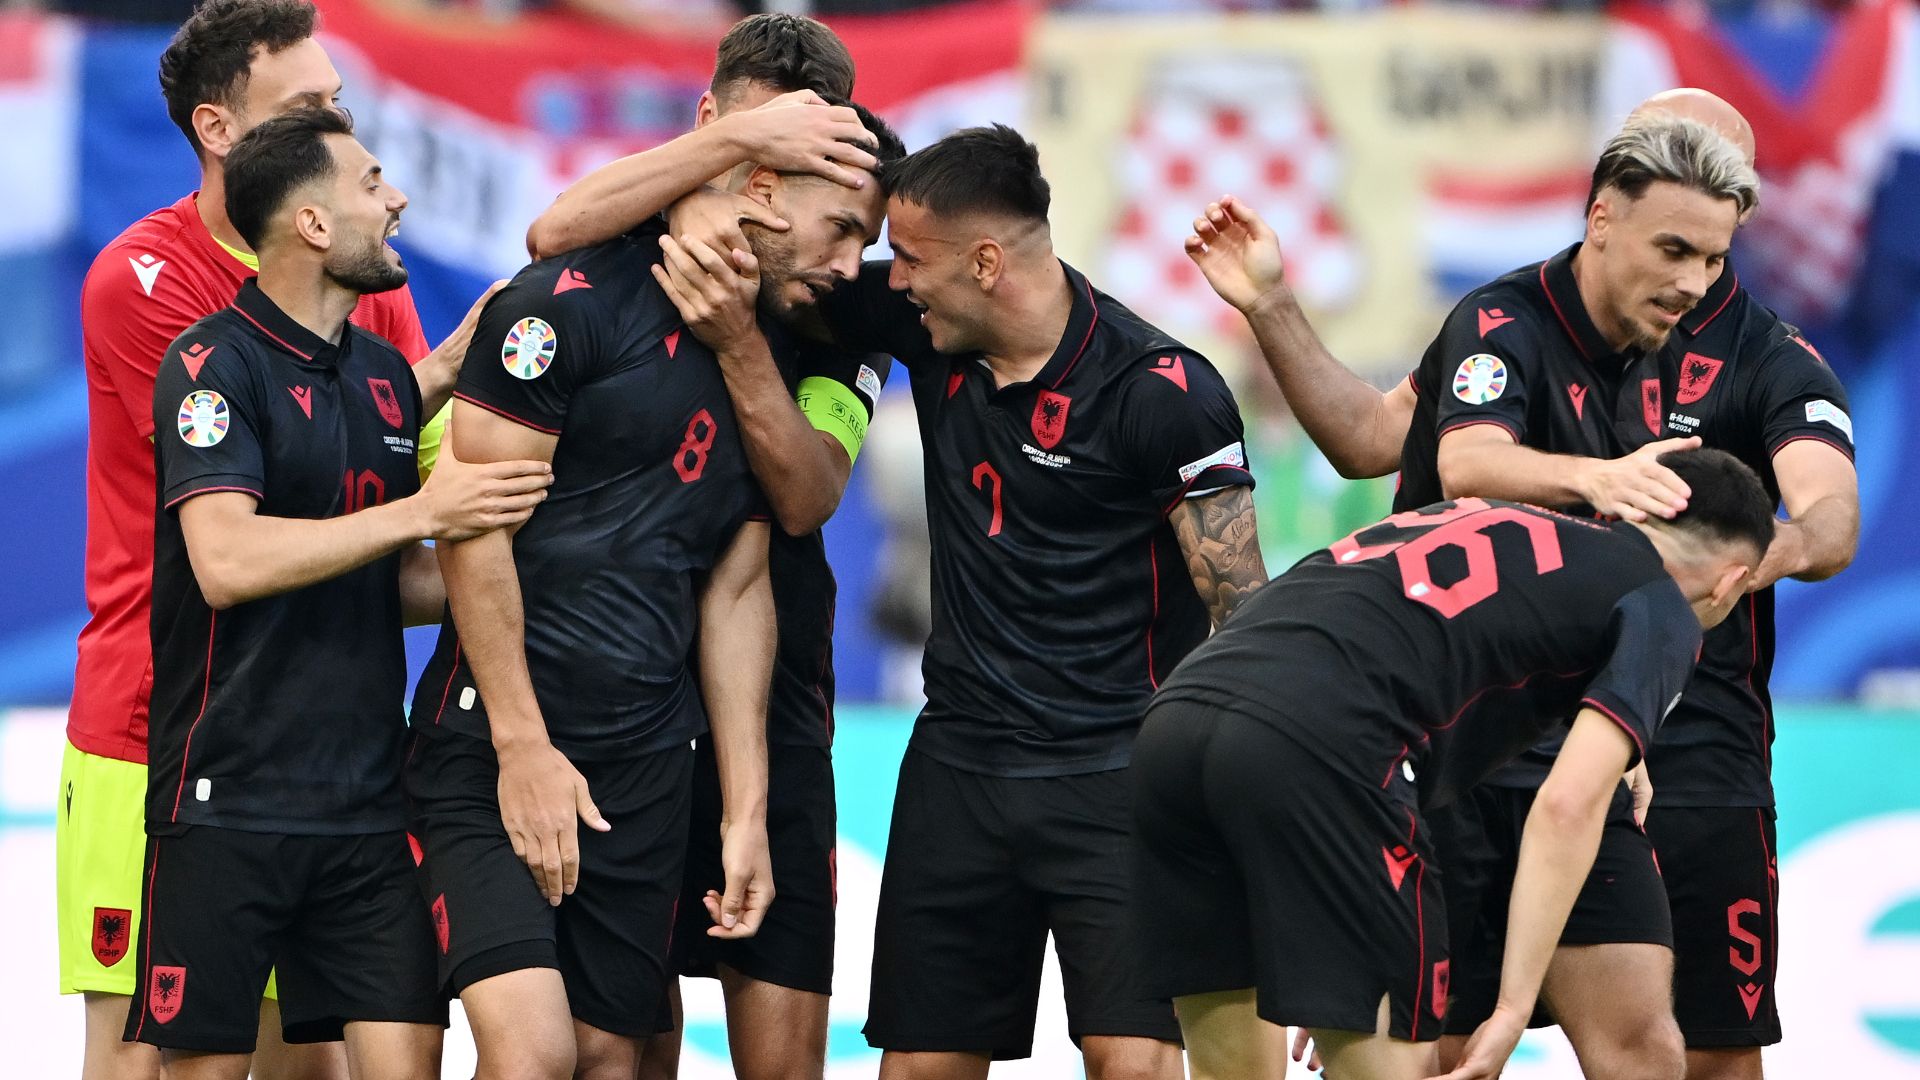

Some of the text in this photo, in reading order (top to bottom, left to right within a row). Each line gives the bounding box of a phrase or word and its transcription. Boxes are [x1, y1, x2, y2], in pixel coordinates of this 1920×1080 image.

[848, 414, 864, 441] RES
[672, 408, 718, 483] 8
[972, 461, 1003, 537] 7
[98, 947, 120, 958] FSHF
[154, 1004, 175, 1014] FSHF
